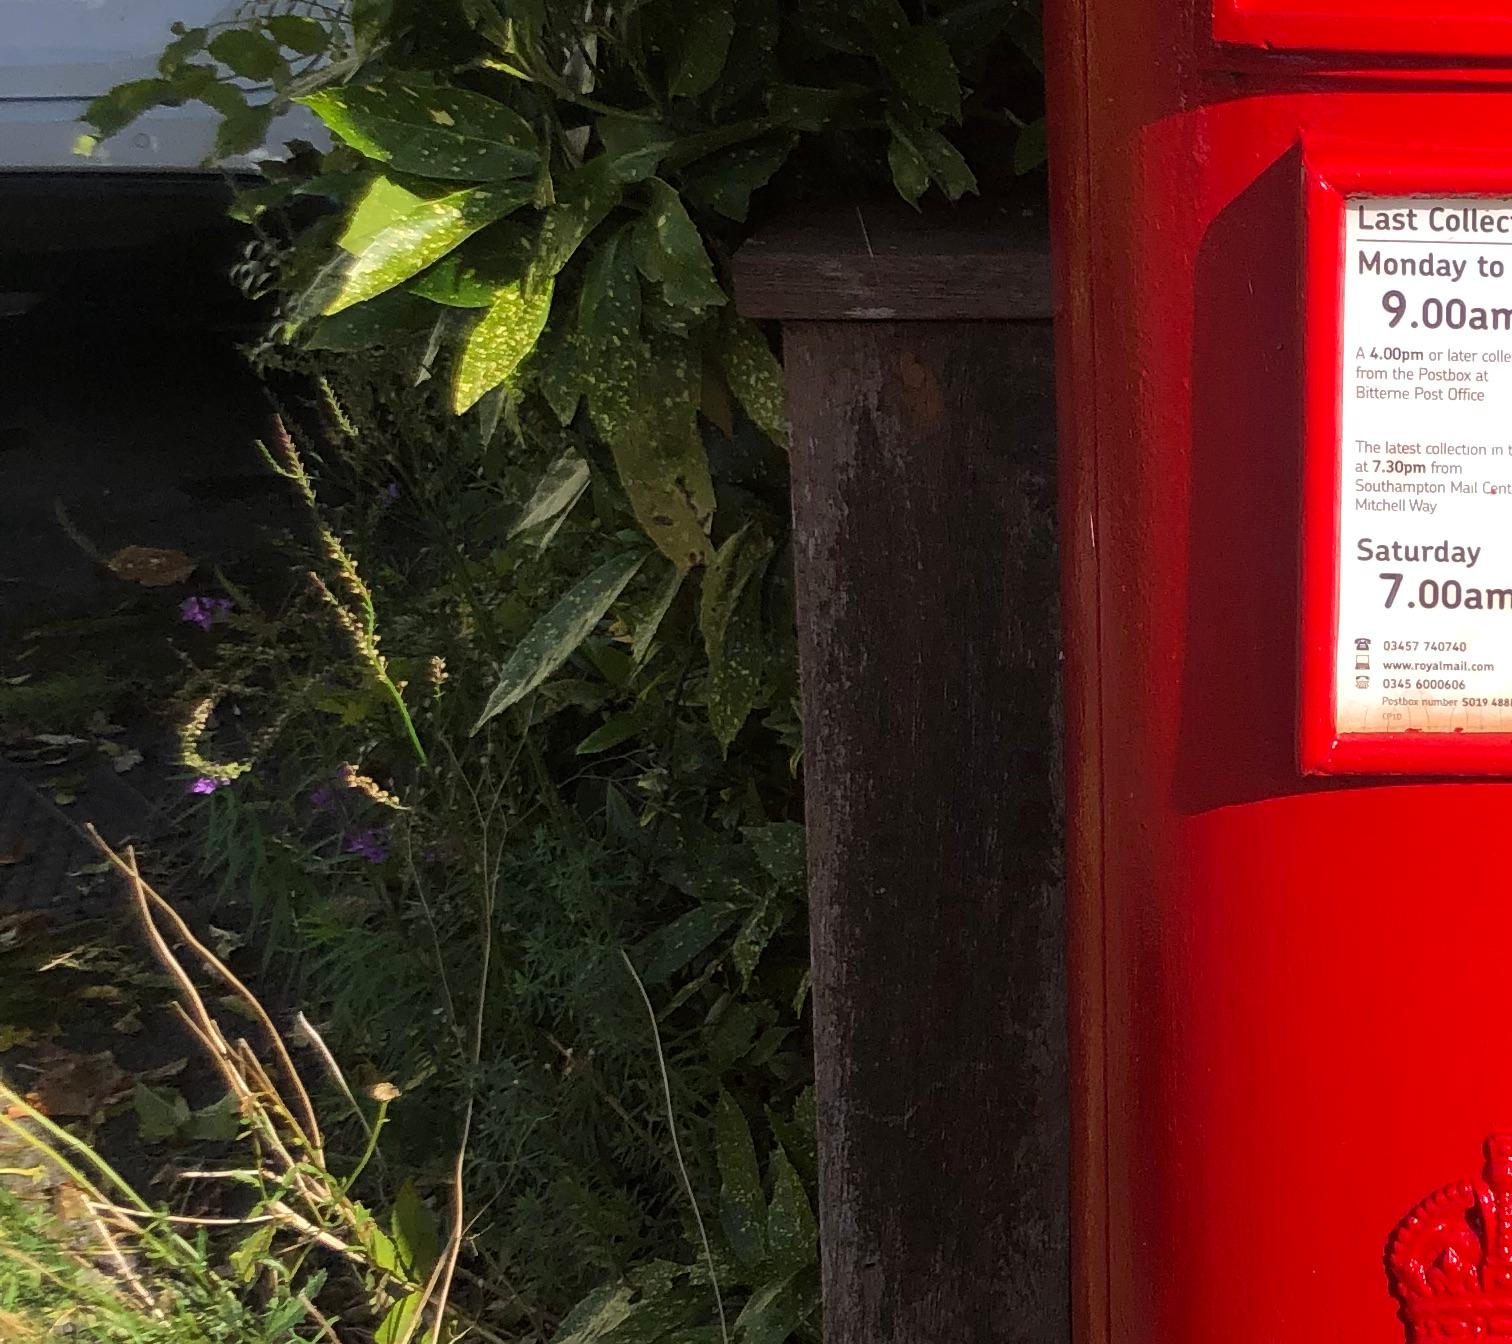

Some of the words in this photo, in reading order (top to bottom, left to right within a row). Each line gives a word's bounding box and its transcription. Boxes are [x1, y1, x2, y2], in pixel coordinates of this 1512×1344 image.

[1358, 205, 1418, 231] Last
[1358, 250, 1467, 282] Monday
[1477, 256, 1504, 277] to
[1356, 346, 1365, 359] A
[1369, 347, 1424, 363] 4.00pm
[1428, 351, 1443, 362] or
[1447, 348, 1478, 362] later
[1356, 366, 1388, 380] from
[1393, 367, 1414, 381] the
[1419, 368, 1471, 382] Postbox
[1475, 370, 1489, 382] at
[1356, 385, 1410, 399] Bitterne
[1414, 387, 1443, 401] Post
[1448, 388, 1485, 401] Office
[1355, 440, 1381, 454] The
[1385, 441, 1421, 455] latest
[1425, 442, 1487, 456] collection
[1491, 445, 1503, 456] in
[1355, 461, 1369, 473] at
[1372, 460, 1426, 476] 7.30pm
[1431, 461, 1463, 474] from
[1355, 478, 1445, 495] Southampton
[1450, 481, 1478, 494] Mail
[1355, 498, 1405, 512] Mitchell
[1409, 499, 1438, 515] Way
[1357, 538, 1481, 568] Saturday
[1383, 640, 1419, 651] 03457
[1423, 641, 1467, 652] 740740
[1382, 661, 1495, 673] www.royalmail.com
[1382, 679, 1412, 690] 0345
[1415, 679, 1466, 690] 6000606
[1381, 697, 1418, 706] Postbox
[1421, 697, 1458, 707] number
